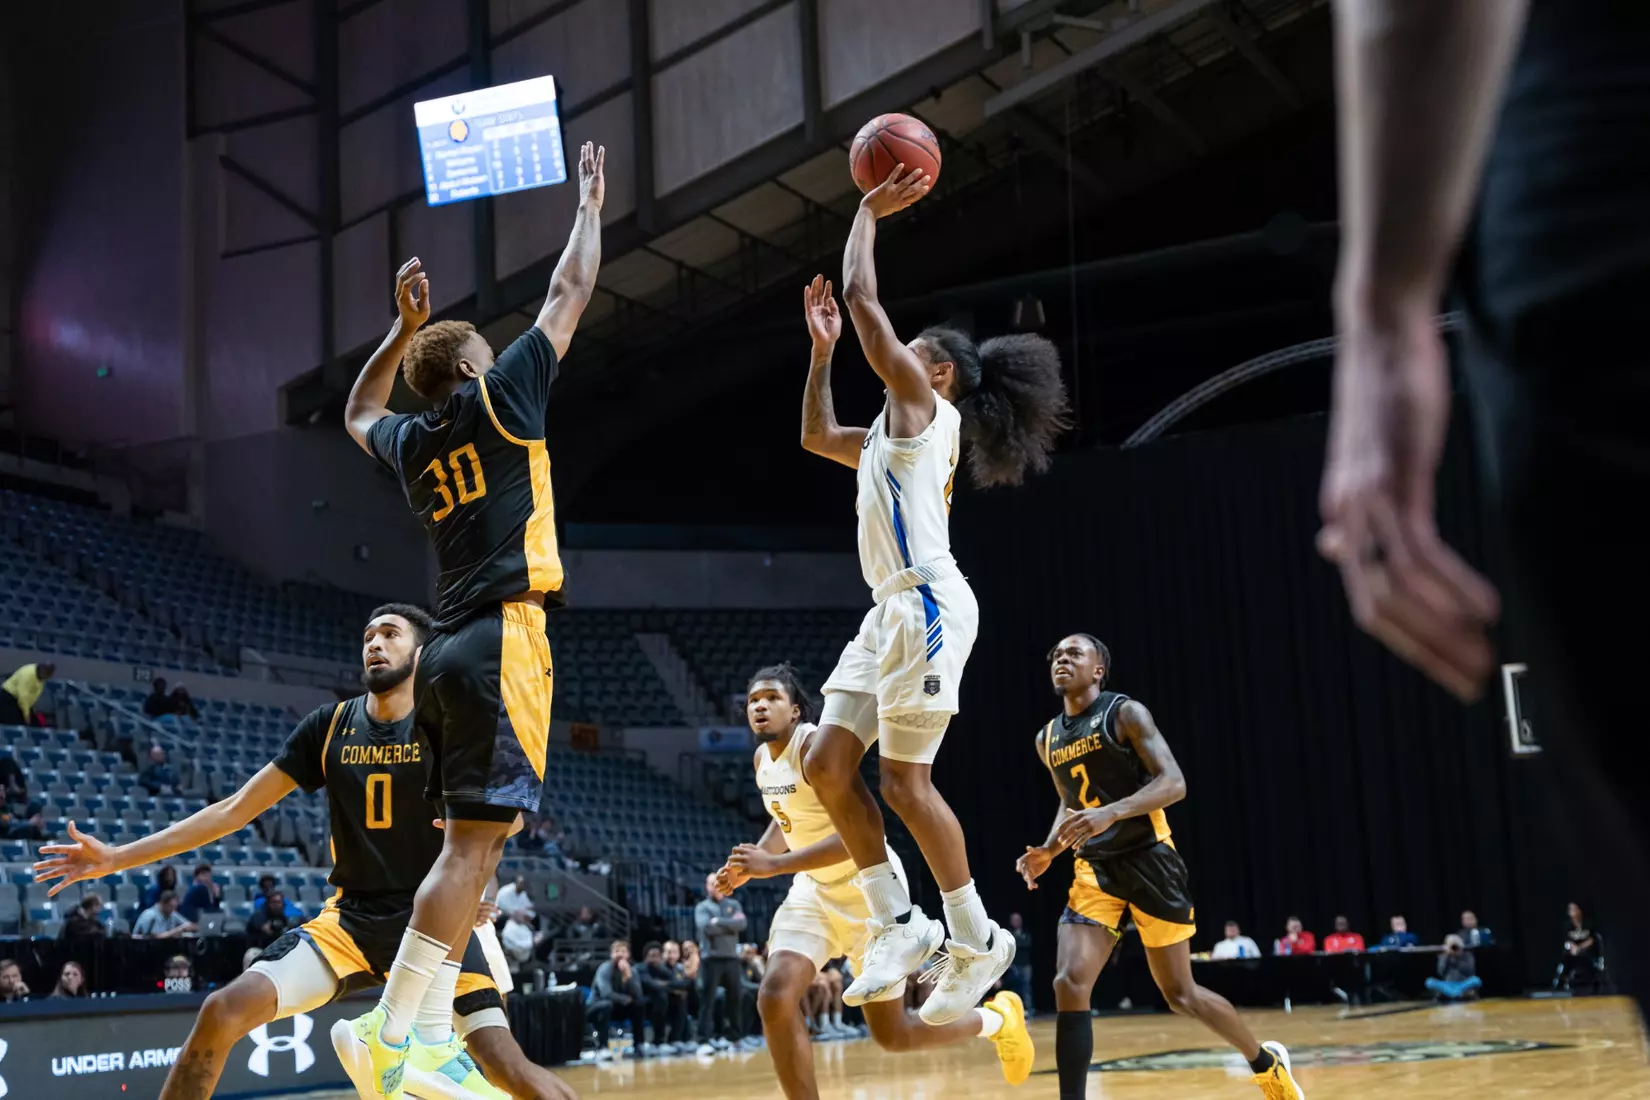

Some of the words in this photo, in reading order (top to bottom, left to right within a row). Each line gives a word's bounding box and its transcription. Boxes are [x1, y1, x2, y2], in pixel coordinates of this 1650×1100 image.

[427, 442, 487, 521] 30
[341, 743, 421, 764] COMMERCE
[1051, 733, 1102, 767] COMMERCE
[366, 773, 392, 829] 0
[1070, 763, 1101, 809] 2
[771, 801, 792, 833] 5
[52, 1052, 124, 1076] UNDER
